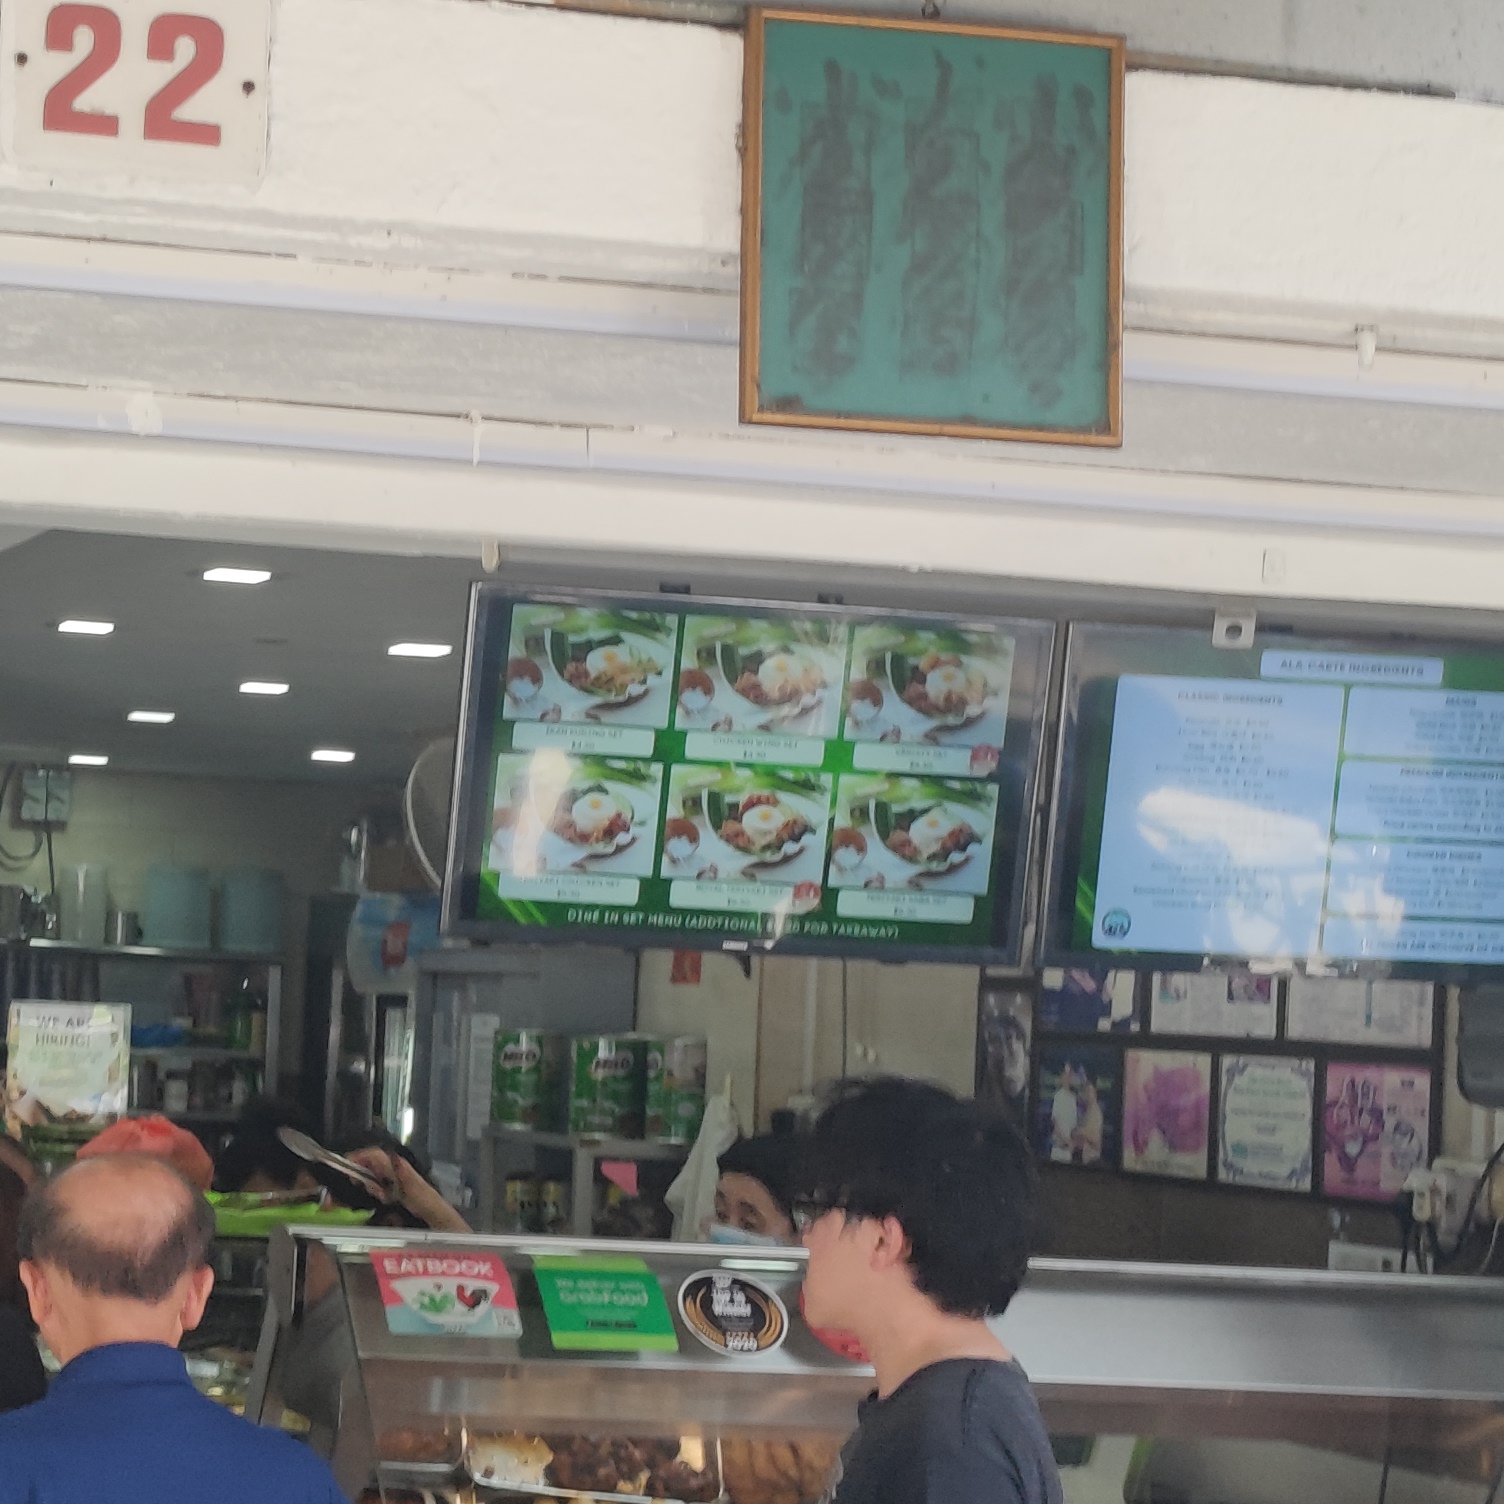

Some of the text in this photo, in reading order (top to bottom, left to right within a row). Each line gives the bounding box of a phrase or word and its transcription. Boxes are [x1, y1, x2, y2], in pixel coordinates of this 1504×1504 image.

[41, 2, 225, 147] 22
[567, 907, 599, 925] DINE
[604, 909, 619, 926] IN
[622, 910, 645, 927] SET
[648, 912, 682, 929] MENU
[803, 920, 829, 936] FOR
[383, 1257, 493, 1276] EATBOOK
